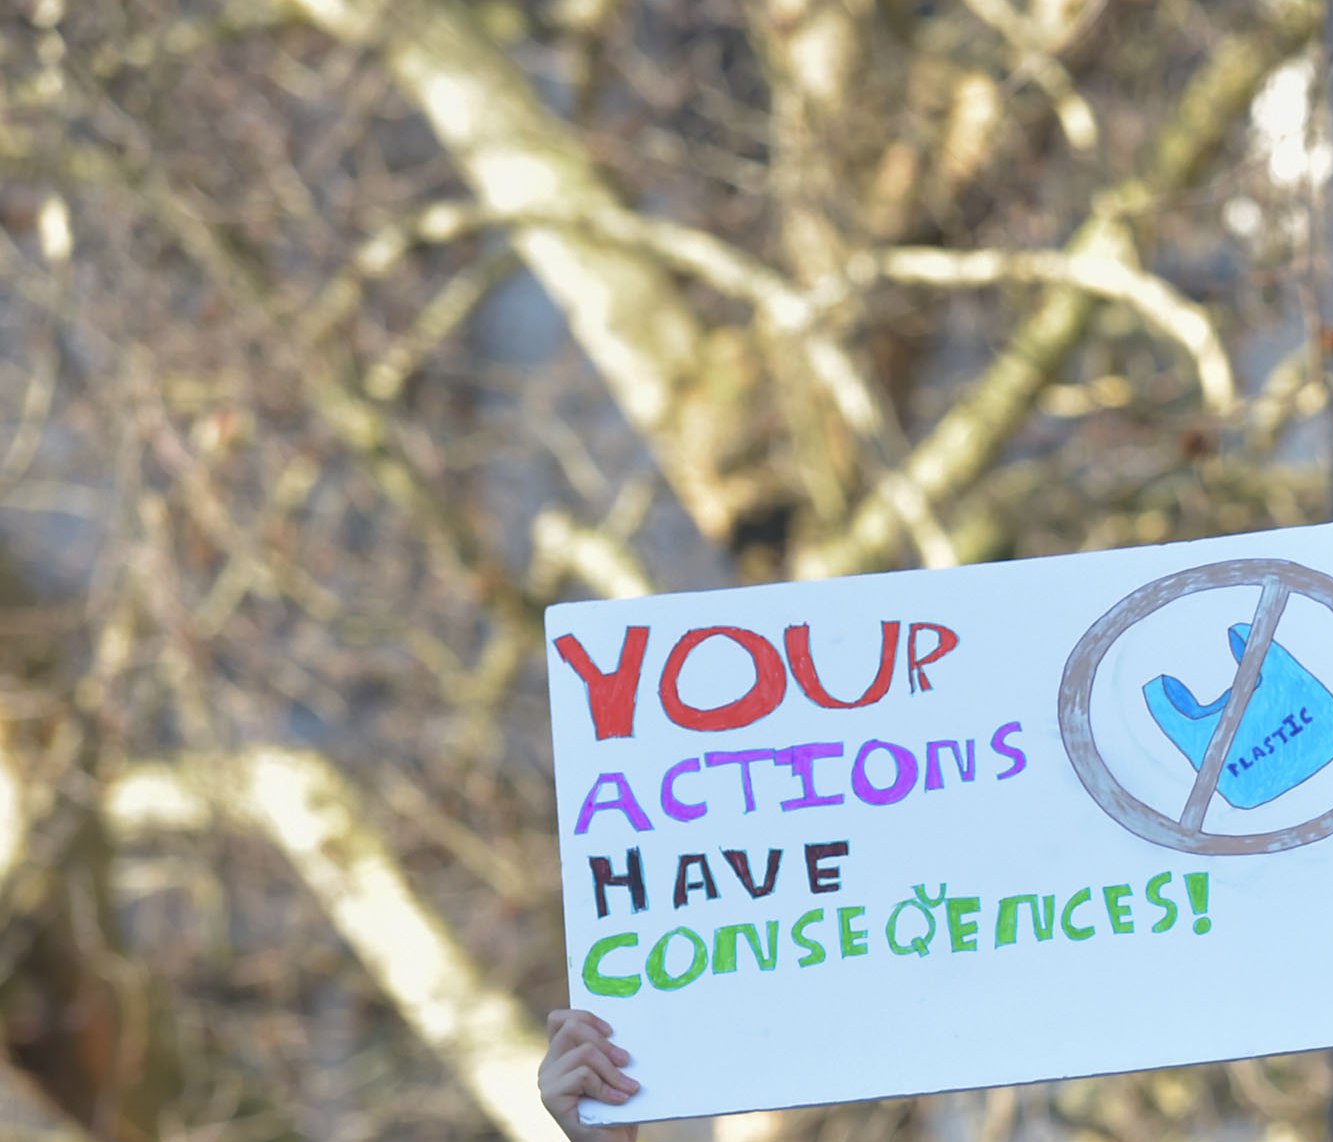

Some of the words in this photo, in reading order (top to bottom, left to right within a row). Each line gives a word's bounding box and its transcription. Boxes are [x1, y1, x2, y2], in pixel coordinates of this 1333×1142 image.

[552, 620, 960, 741] YOUR
[574, 721, 1029, 835] ACTIONS
[1226, 706, 1313, 777] PLASTIC
[589, 840, 850, 918] HAVE
